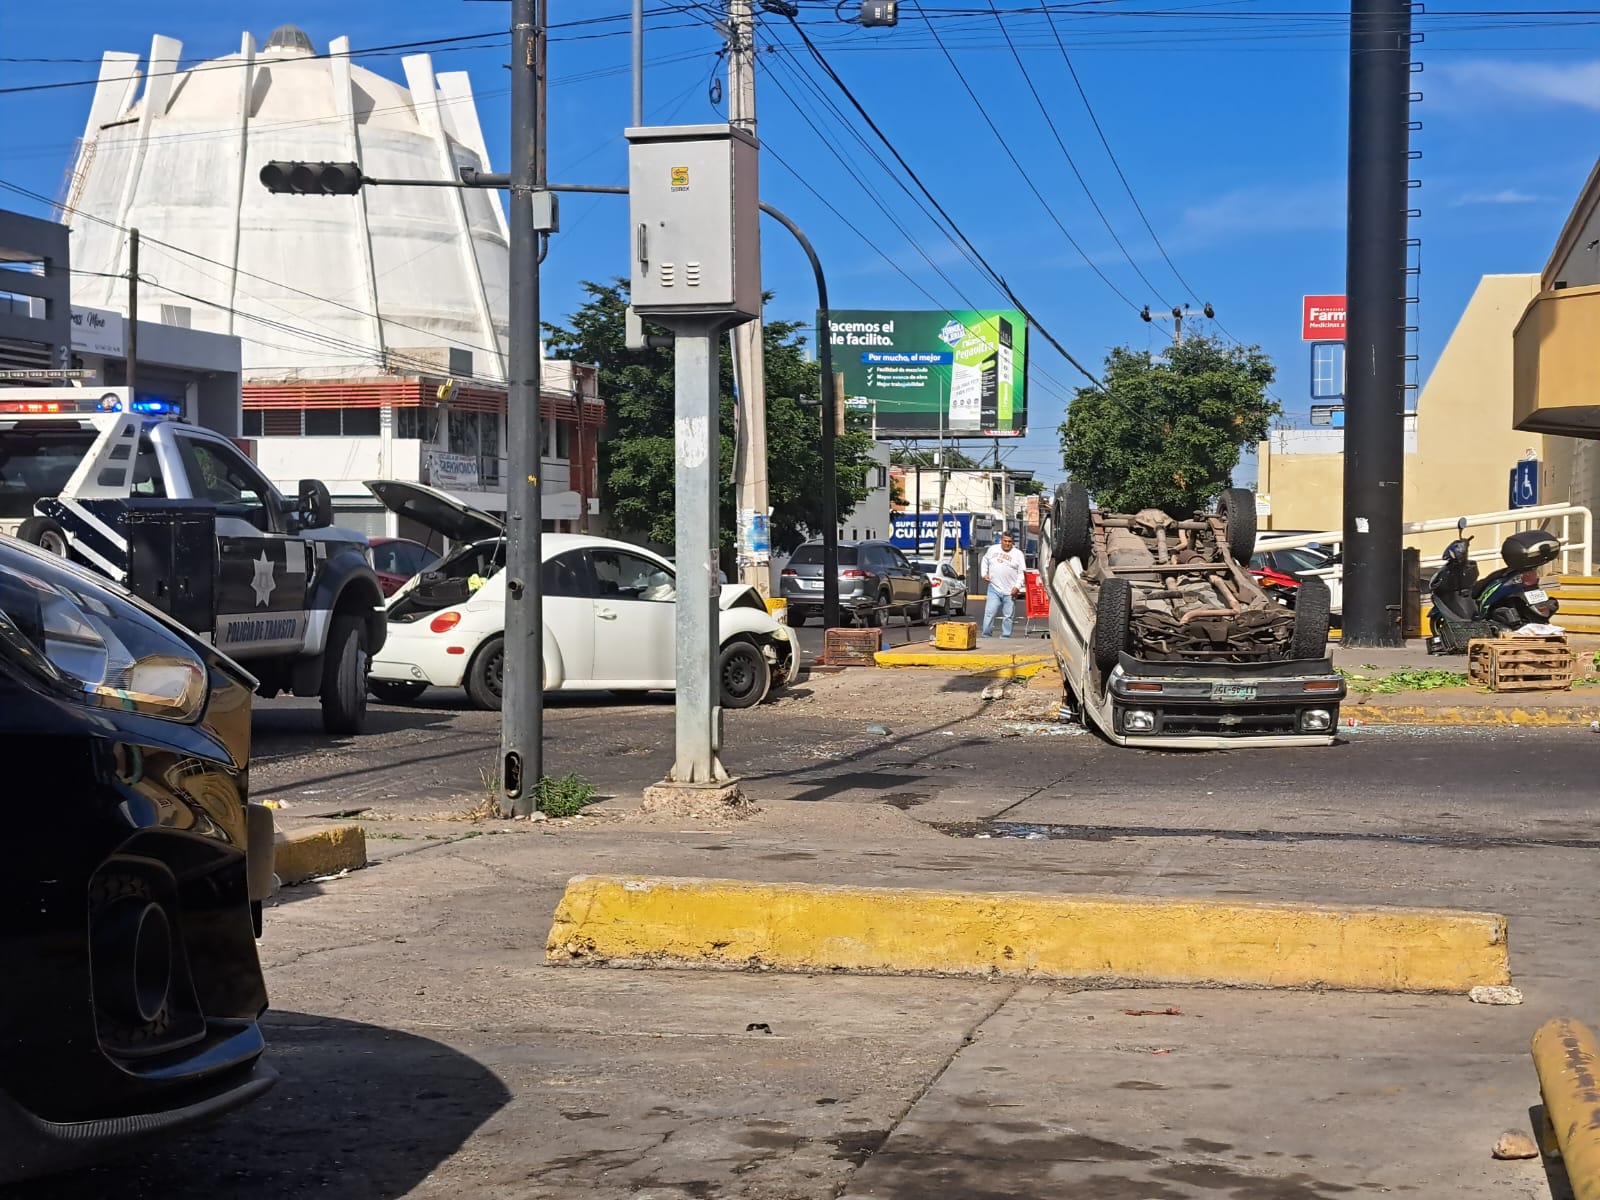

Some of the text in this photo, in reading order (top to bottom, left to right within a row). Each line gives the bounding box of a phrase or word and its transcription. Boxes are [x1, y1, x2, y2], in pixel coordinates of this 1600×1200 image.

[828, 319, 894, 333] acemos el
[829, 332, 894, 346] le facilito.
[869, 353, 941, 363] Por mucho, el mejor
[254, 620, 265, 641] DE
[264, 618, 297, 640] TRANSITO
